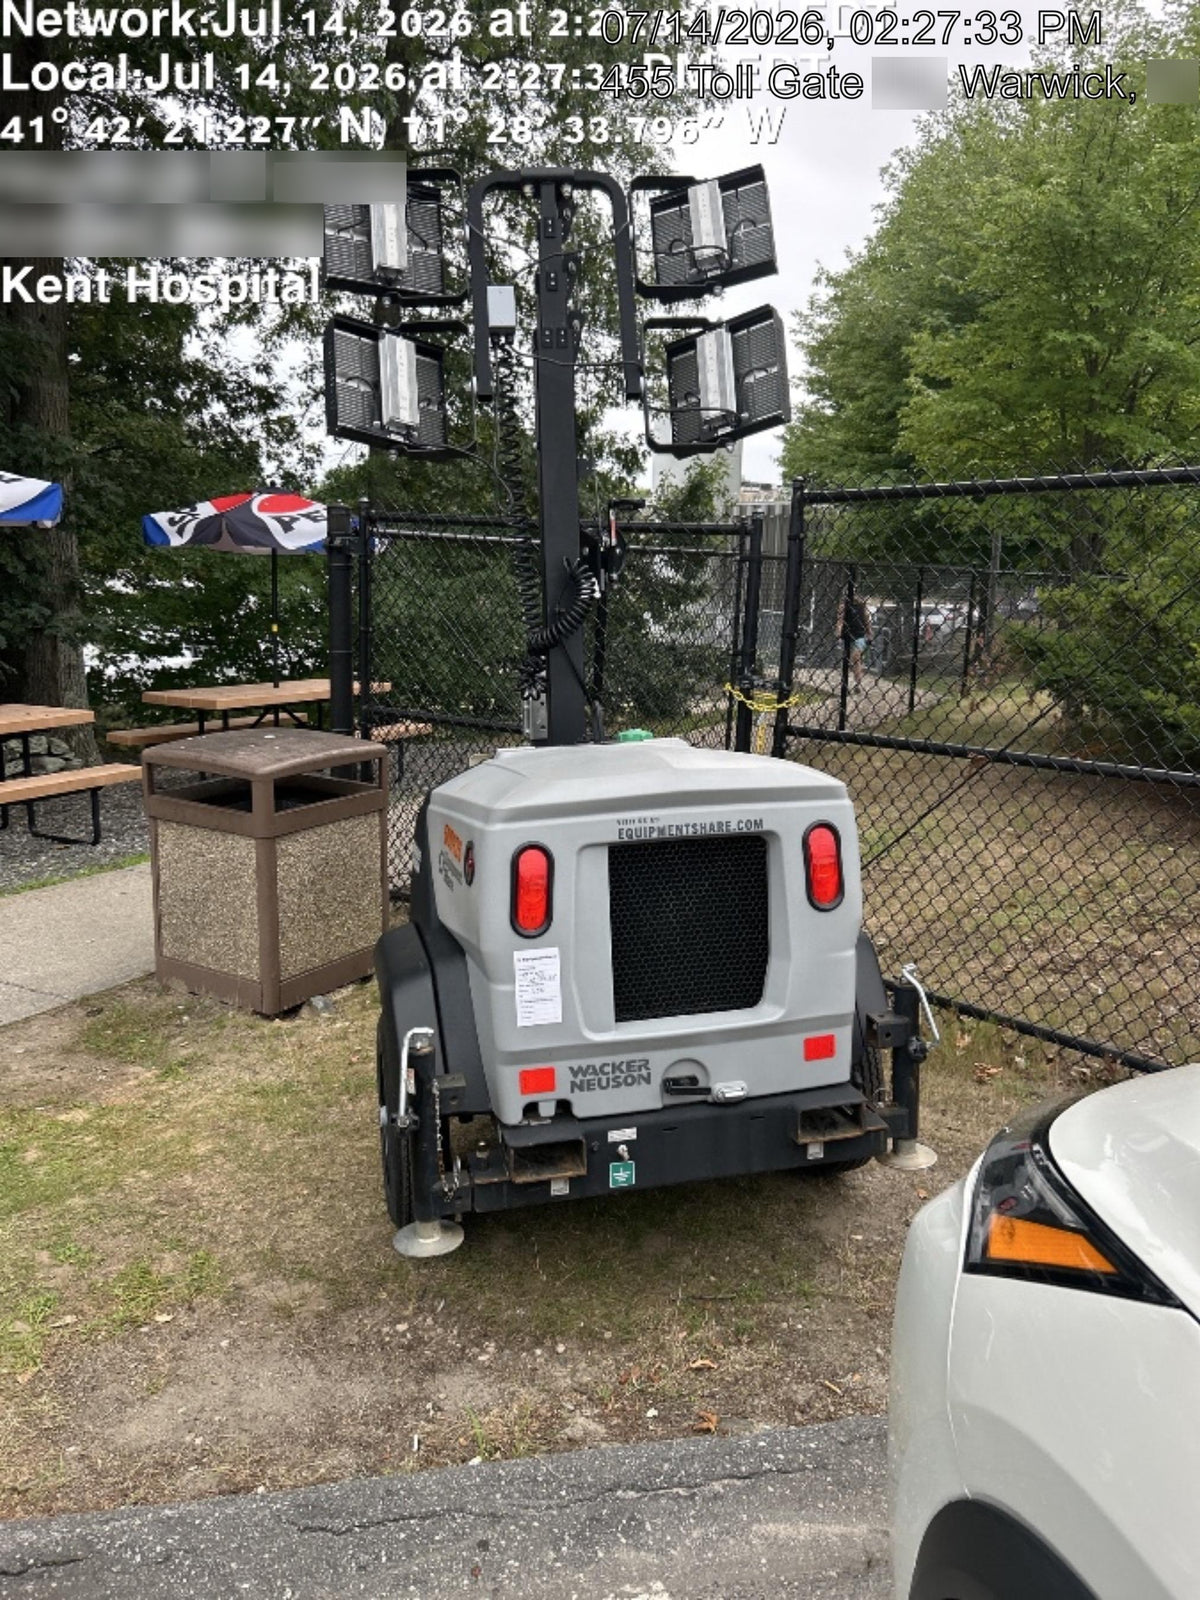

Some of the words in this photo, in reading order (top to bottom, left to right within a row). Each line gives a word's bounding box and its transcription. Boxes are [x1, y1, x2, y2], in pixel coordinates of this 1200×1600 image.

[618, 818, 764, 840] EQUIPMENTSHARE.COM
[568, 1059, 652, 1079] WACKER
[570, 1071, 652, 1094] NEUSON
